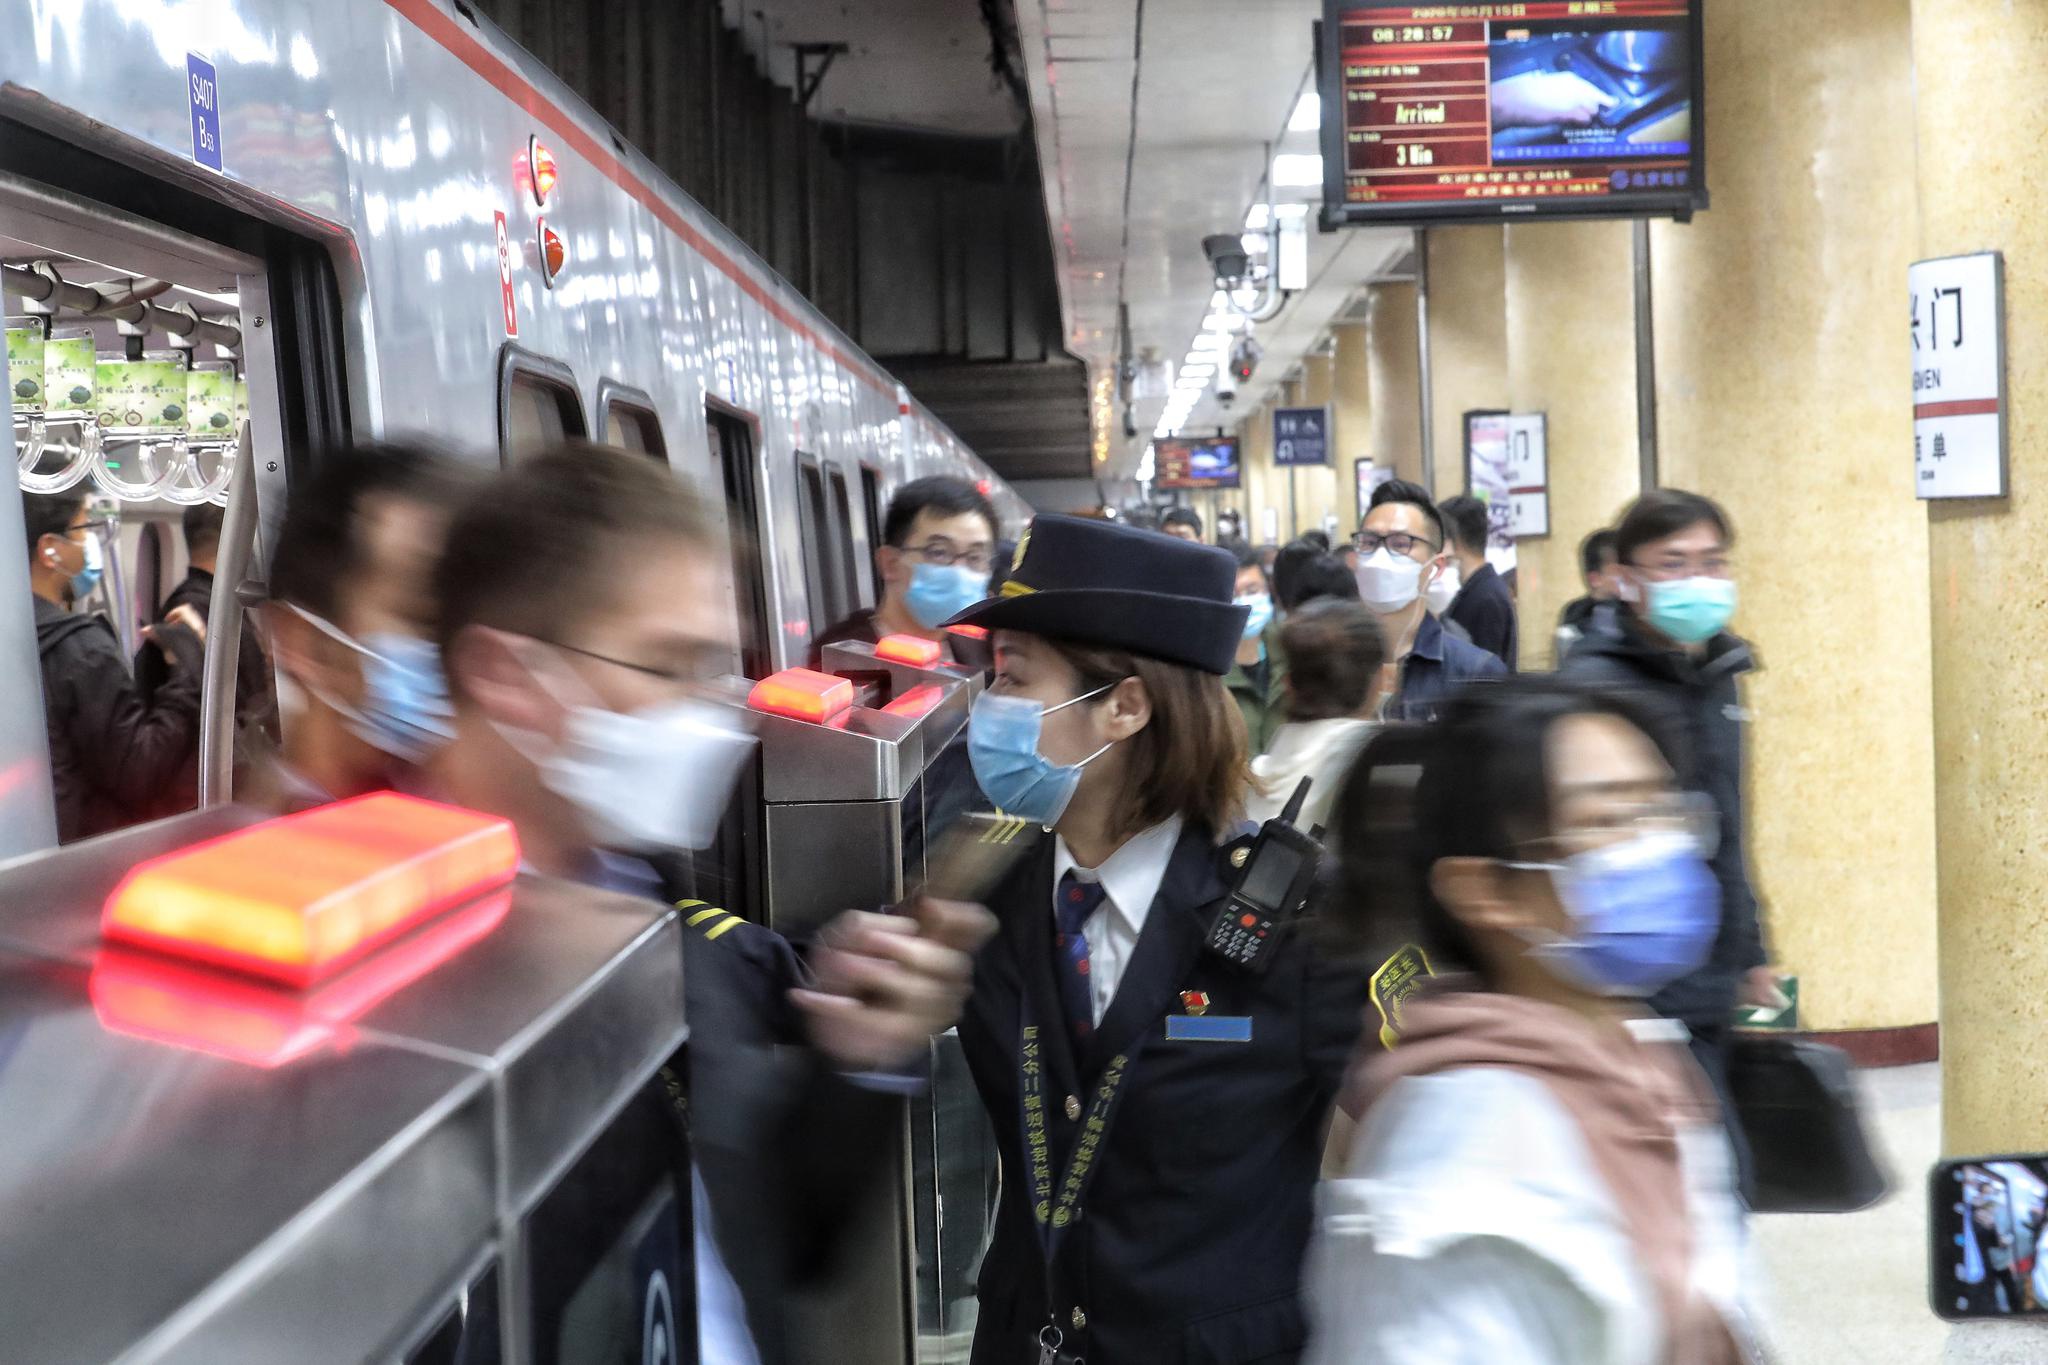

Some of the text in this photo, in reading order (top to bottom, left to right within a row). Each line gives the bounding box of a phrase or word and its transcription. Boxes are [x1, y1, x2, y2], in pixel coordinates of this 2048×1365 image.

[192, 73, 213, 111] S407
[1395, 102, 1445, 124] Arrived
[1396, 144, 1407, 166] 3
[1022, 1026, 1051, 1197] 北京地铁运营二分公司
